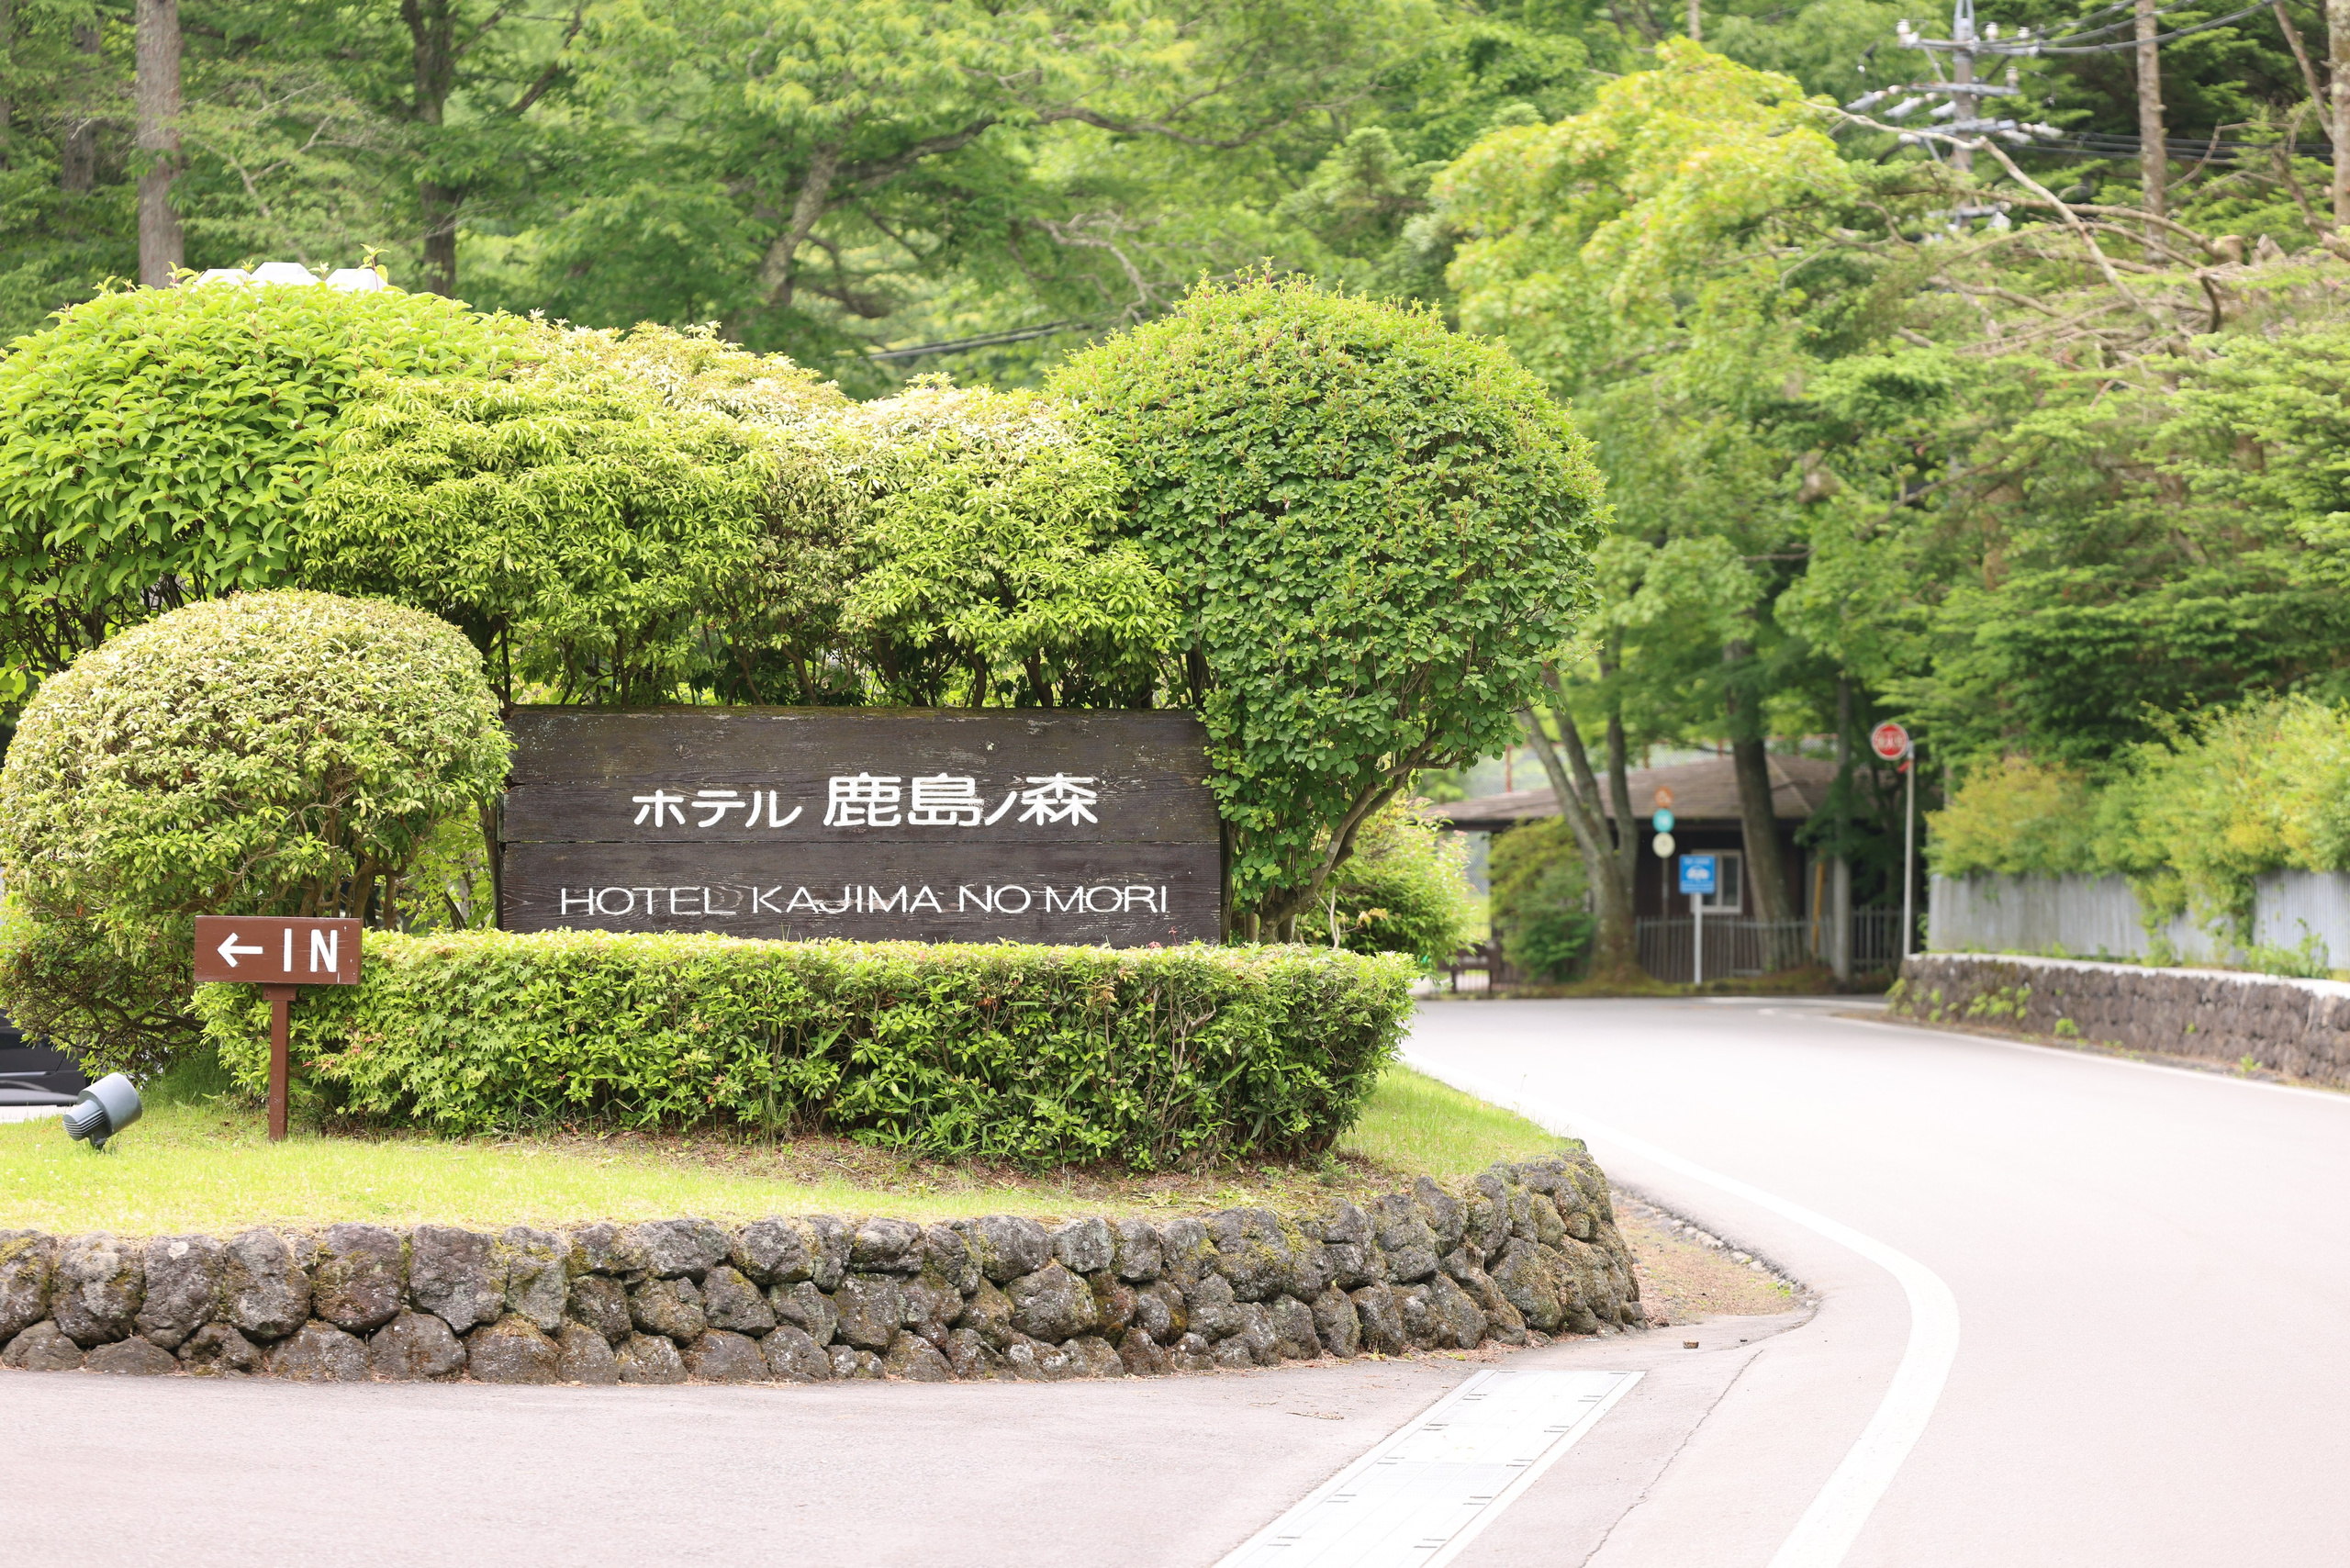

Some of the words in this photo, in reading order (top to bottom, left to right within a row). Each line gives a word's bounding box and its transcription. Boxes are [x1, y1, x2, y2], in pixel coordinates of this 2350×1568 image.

[632, 790, 803, 828] ホテル
[822, 771, 1099, 827] 鹿島ノ森
[561, 886, 734, 916] HOTEL
[752, 884, 944, 914] KAJIMA
[957, 883, 1032, 914] NO
[1045, 884, 1167, 914] MORI
[283, 928, 338, 973] IN
